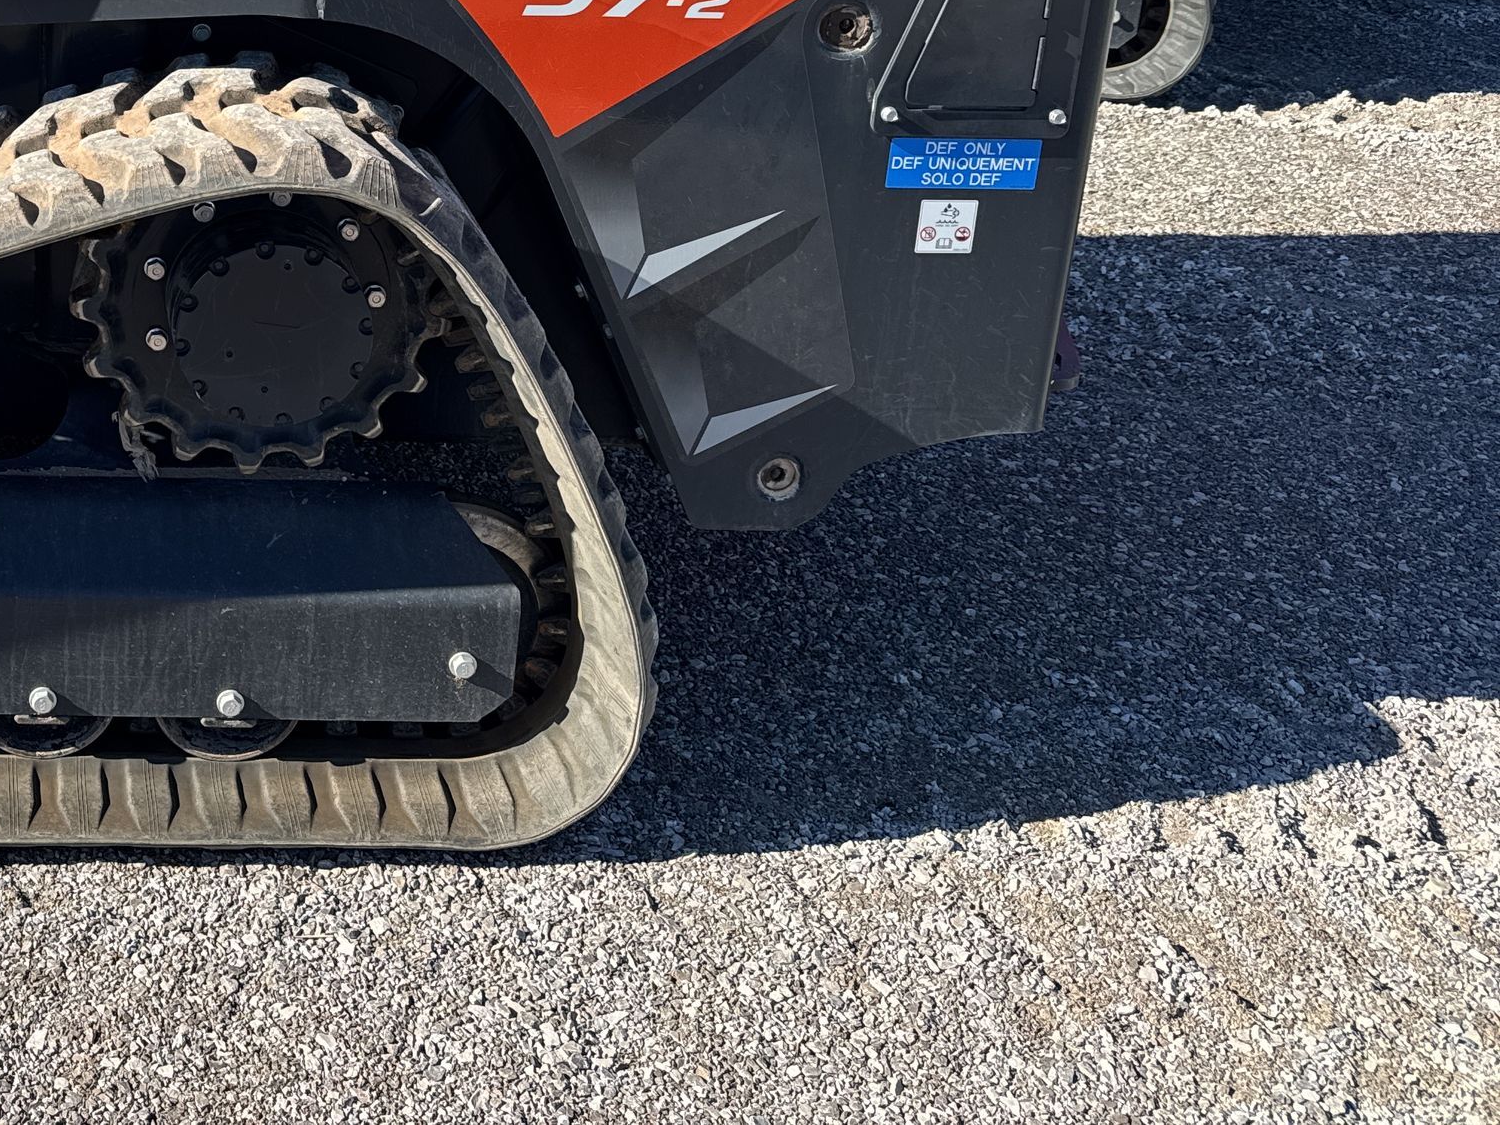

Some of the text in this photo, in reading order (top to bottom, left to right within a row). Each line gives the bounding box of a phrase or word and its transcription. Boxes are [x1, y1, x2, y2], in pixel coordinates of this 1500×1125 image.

[925, 141, 1006, 155] DEF ONLY
[891, 156, 1036, 171] DEF UNIQUEMENT
[920, 173, 1002, 186] SOLO DEF
